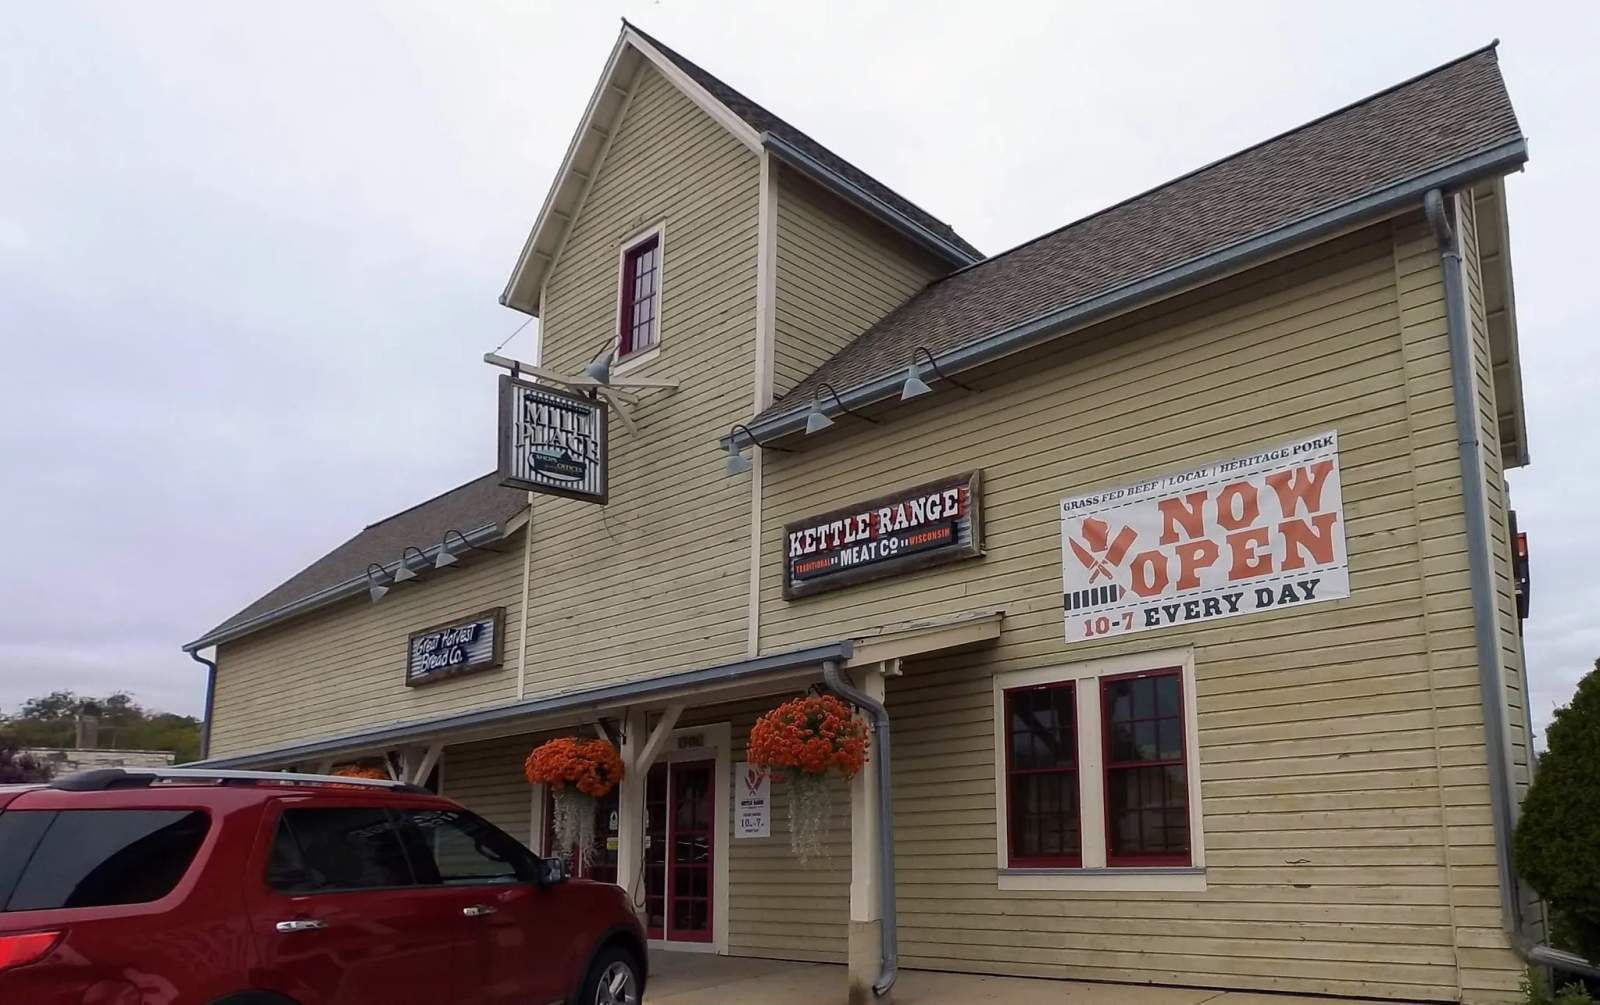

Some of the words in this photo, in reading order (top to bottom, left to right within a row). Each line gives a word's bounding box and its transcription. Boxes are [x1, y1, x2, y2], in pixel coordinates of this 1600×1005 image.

[523, 400, 591, 438] MILL
[515, 422, 599, 466] PLACE
[1063, 496, 1100, 512] GRASS
[1102, 489, 1125, 503] FED
[1127, 480, 1159, 495] BEEF
[1168, 469, 1209, 486] LOCAL
[1219, 448, 1290, 474] HERITAGE
[1293, 435, 1335, 455] PORK
[789, 512, 871, 558] KETTLE
[878, 488, 960, 534] RANGE
[1158, 460, 1334, 546] NOW
[840, 542, 878, 567] MEAT
[909, 527, 950, 546] WISCONSIN
[1129, 512, 1337, 598] OPEN
[796, 558, 831, 574] TRADITIONAL
[1083, 612, 1134, 637] 10-7
[1143, 592, 1244, 627] EVERY
[1255, 578, 1320, 609] DAY
[420, 649, 449, 673] Bread
